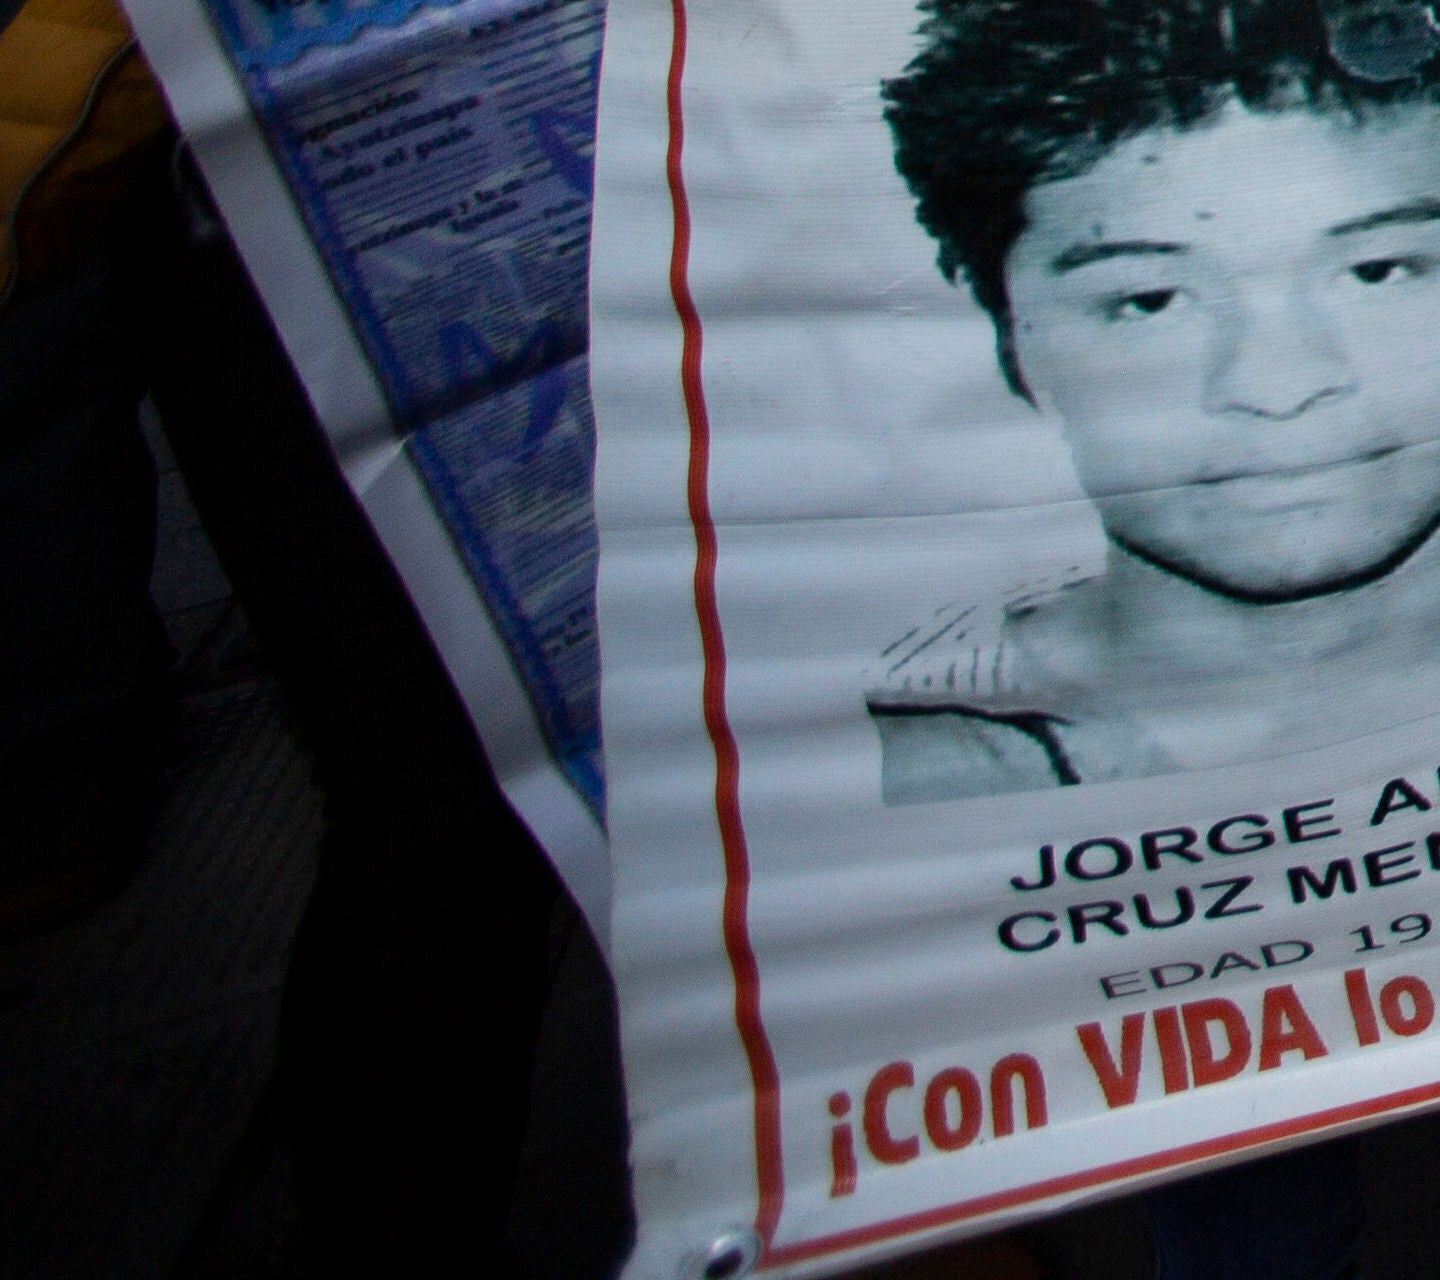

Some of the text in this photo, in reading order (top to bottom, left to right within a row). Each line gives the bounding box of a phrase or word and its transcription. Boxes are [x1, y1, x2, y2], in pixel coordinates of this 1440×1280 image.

[1009, 797, 1343, 894] JORGE
[998, 874, 1264, 954] CRUZ
[1098, 939, 1316, 1000] EDAD
[1348, 911, 1433, 955] 19
[827, 1051, 1050, 1200] ¡Con
[1074, 983, 1330, 1110] VIDA
[1343, 967, 1436, 1048] lo
